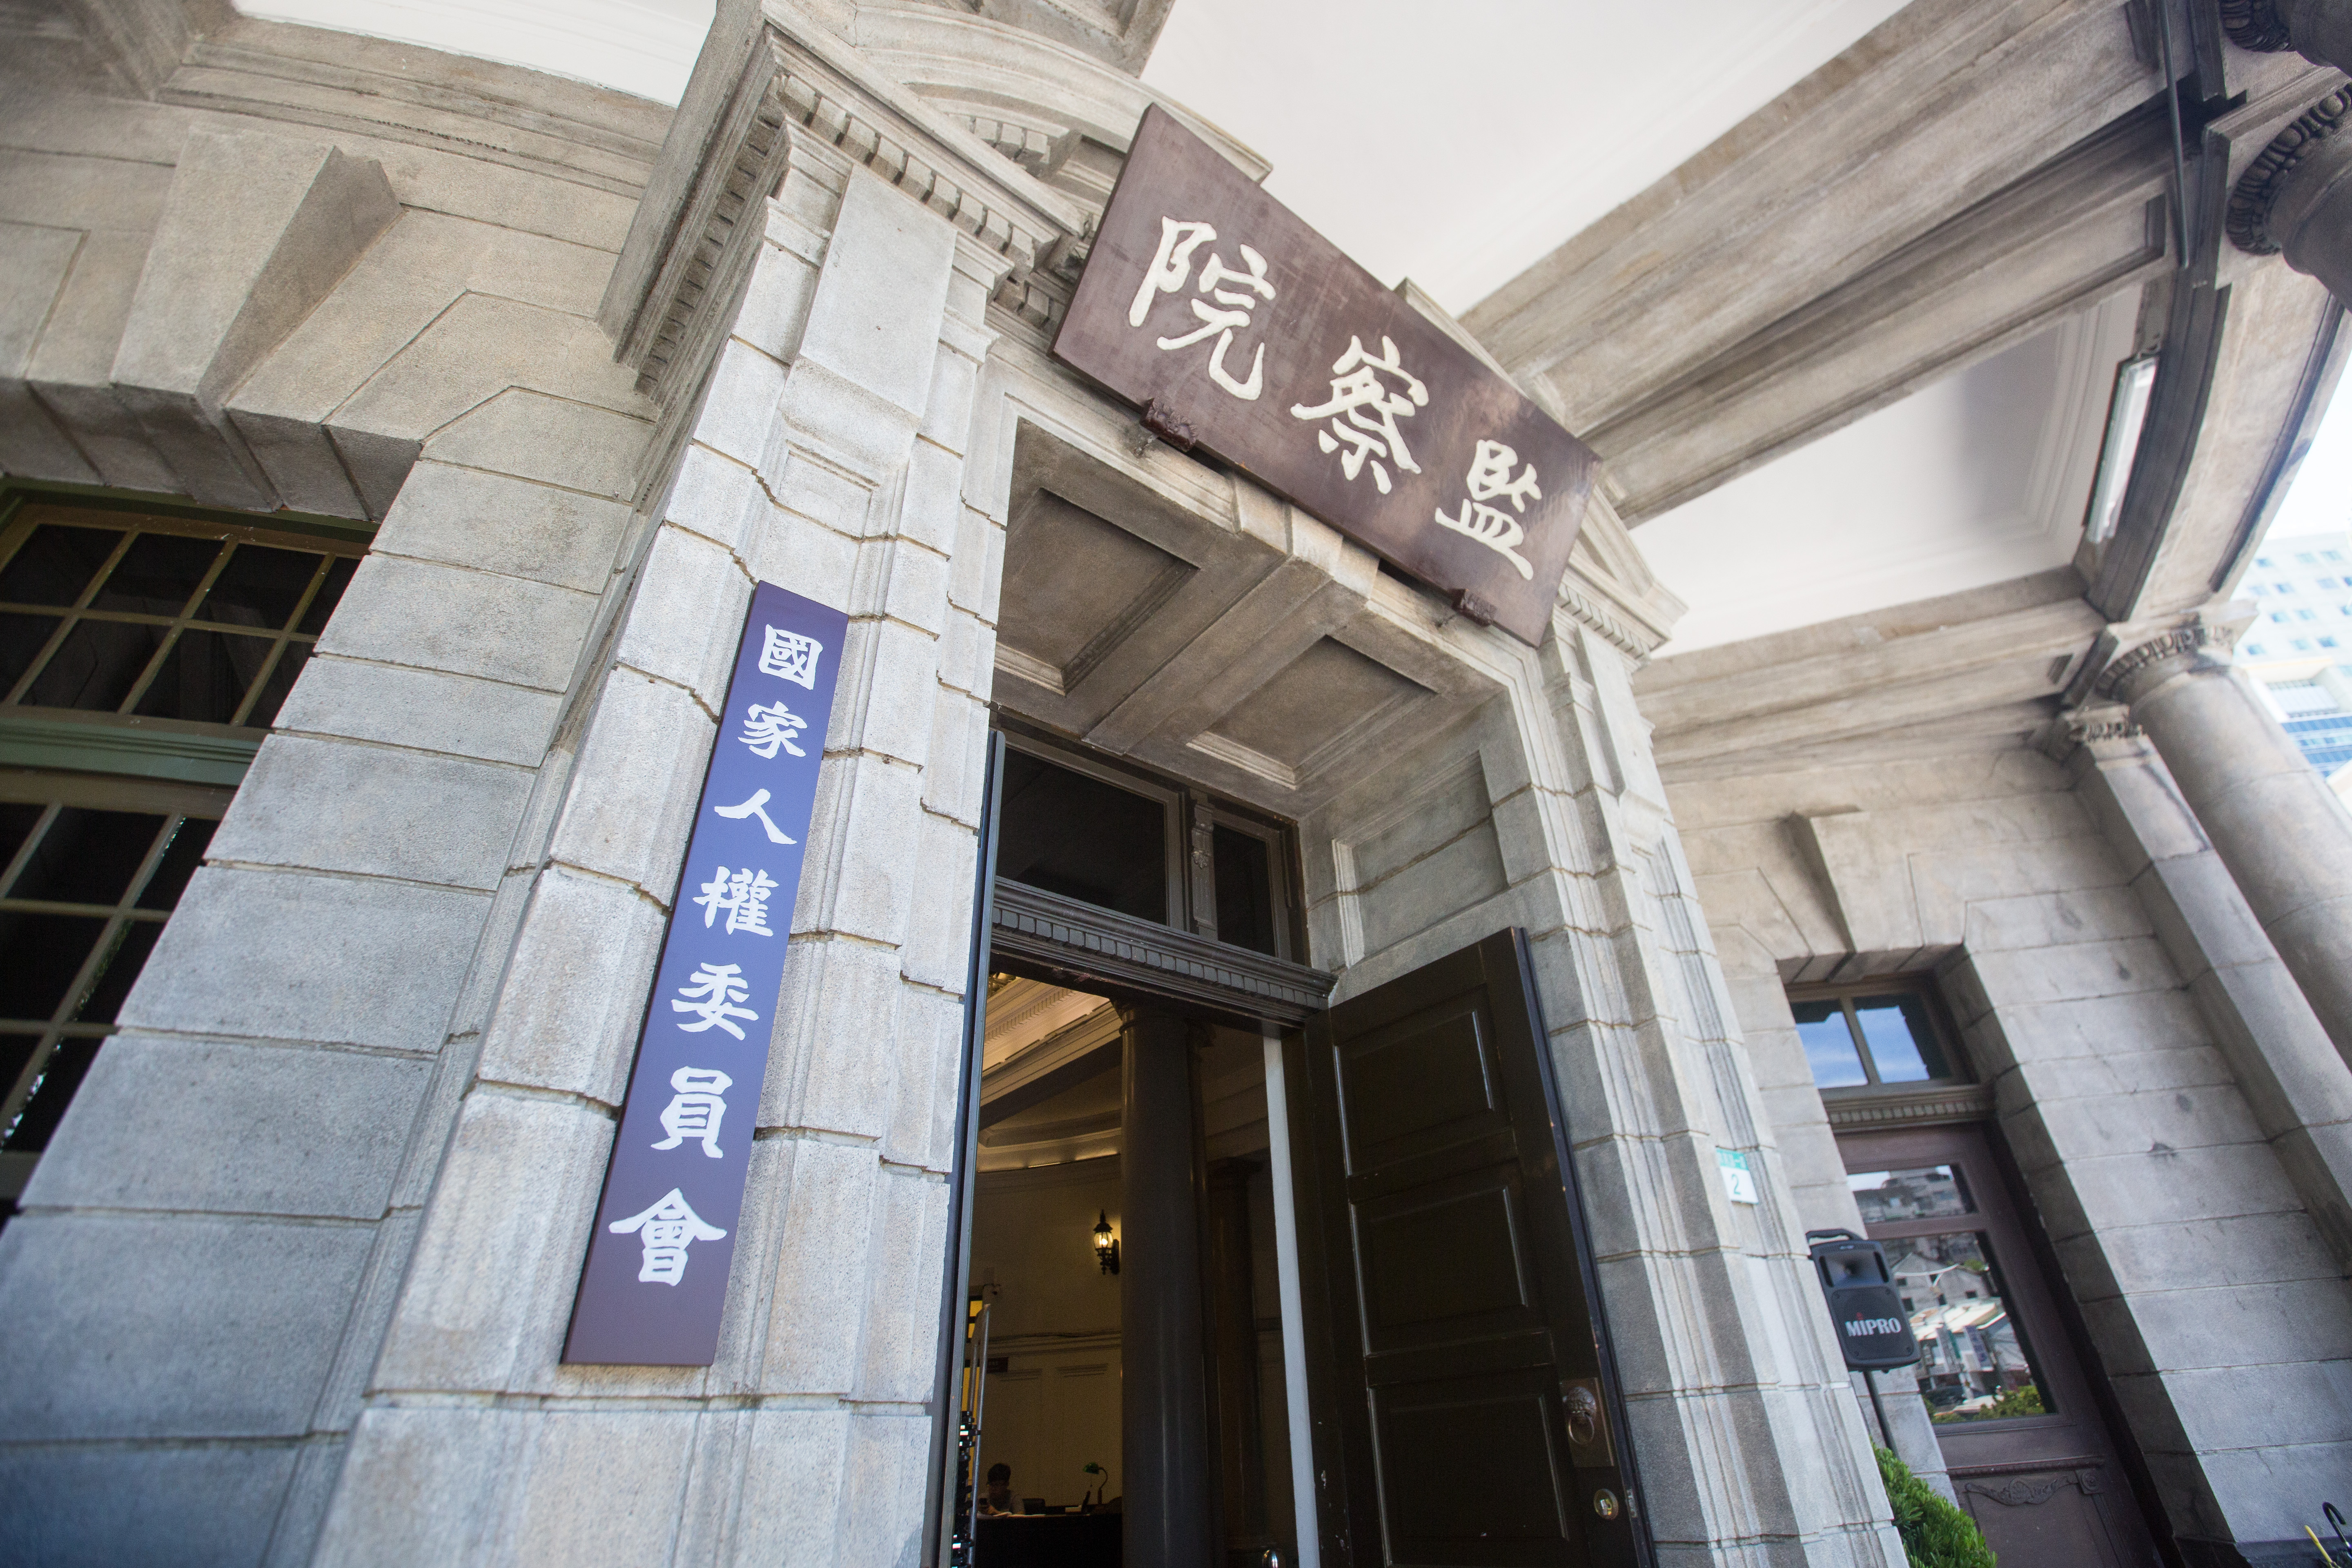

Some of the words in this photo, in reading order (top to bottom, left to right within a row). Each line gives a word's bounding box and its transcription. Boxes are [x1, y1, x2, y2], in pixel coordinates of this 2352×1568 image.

[608, 623, 822, 1287] 國家人權委員會
[1731, 1174, 1741, 1195] 2
